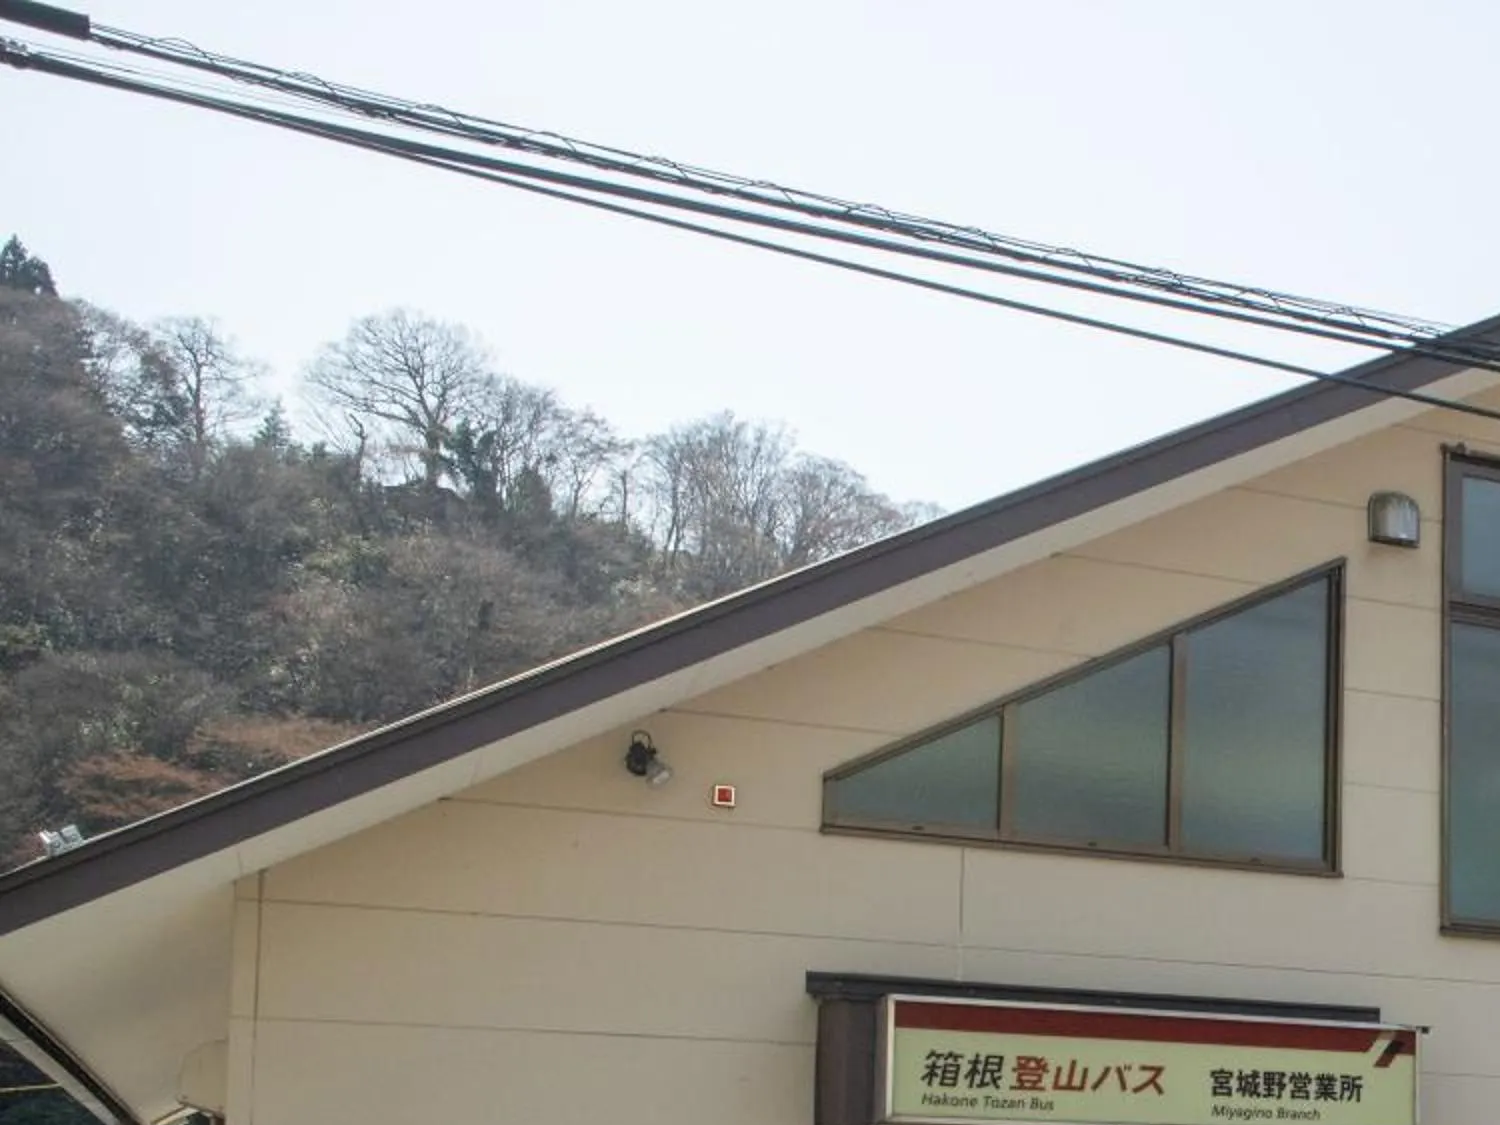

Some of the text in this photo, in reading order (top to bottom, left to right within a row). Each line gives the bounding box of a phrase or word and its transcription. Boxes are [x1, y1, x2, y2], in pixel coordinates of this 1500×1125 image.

[920, 1049, 1166, 1097] 箱根登山バス
[1210, 1068, 1364, 1103] 宮城野営業所
[921, 1093, 1055, 1112] Hakone Tozan Bus
[1211, 1104, 1321, 1121] Miyagino Branch
